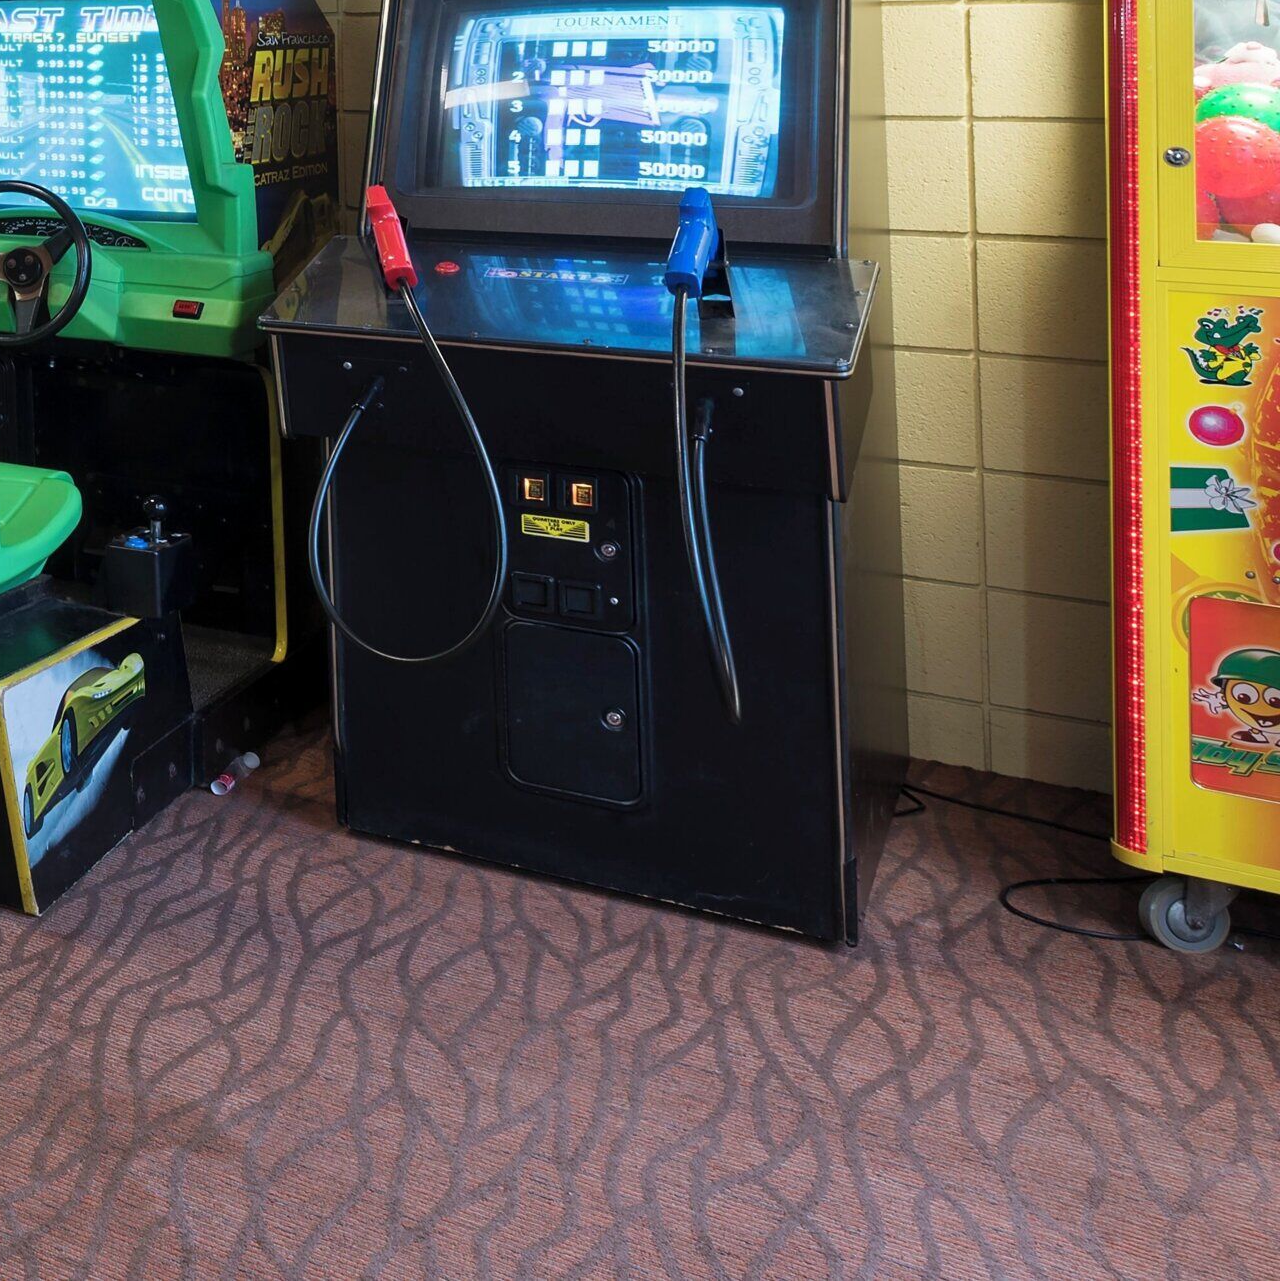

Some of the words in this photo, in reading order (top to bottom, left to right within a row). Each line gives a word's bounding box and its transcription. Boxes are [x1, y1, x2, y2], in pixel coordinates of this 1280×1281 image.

[555, 15, 683, 28] TOURNAMENT
[1, 33, 54, 43] TRACK
[76, 31, 142, 43] SUNSET
[257, 31, 279, 47] San
[281, 30, 329, 46] Francisco
[647, 40, 715, 53] 50000
[250, 48, 329, 103] RUSH
[511, 71, 524, 83] 2
[645, 70, 714, 84] 50000
[509, 100, 523, 113] 3
[251, 100, 328, 165] ROCK
[508, 130, 522, 143] 4
[641, 130, 707, 145] 50000
[135, 165, 190, 180] INSE
[254, 169, 290, 187] CATRAZ
[292, 162, 328, 179] EDITION
[507, 160, 521, 174] 5
[639, 162, 705, 179] 50000
[519, 270, 591, 281] START
